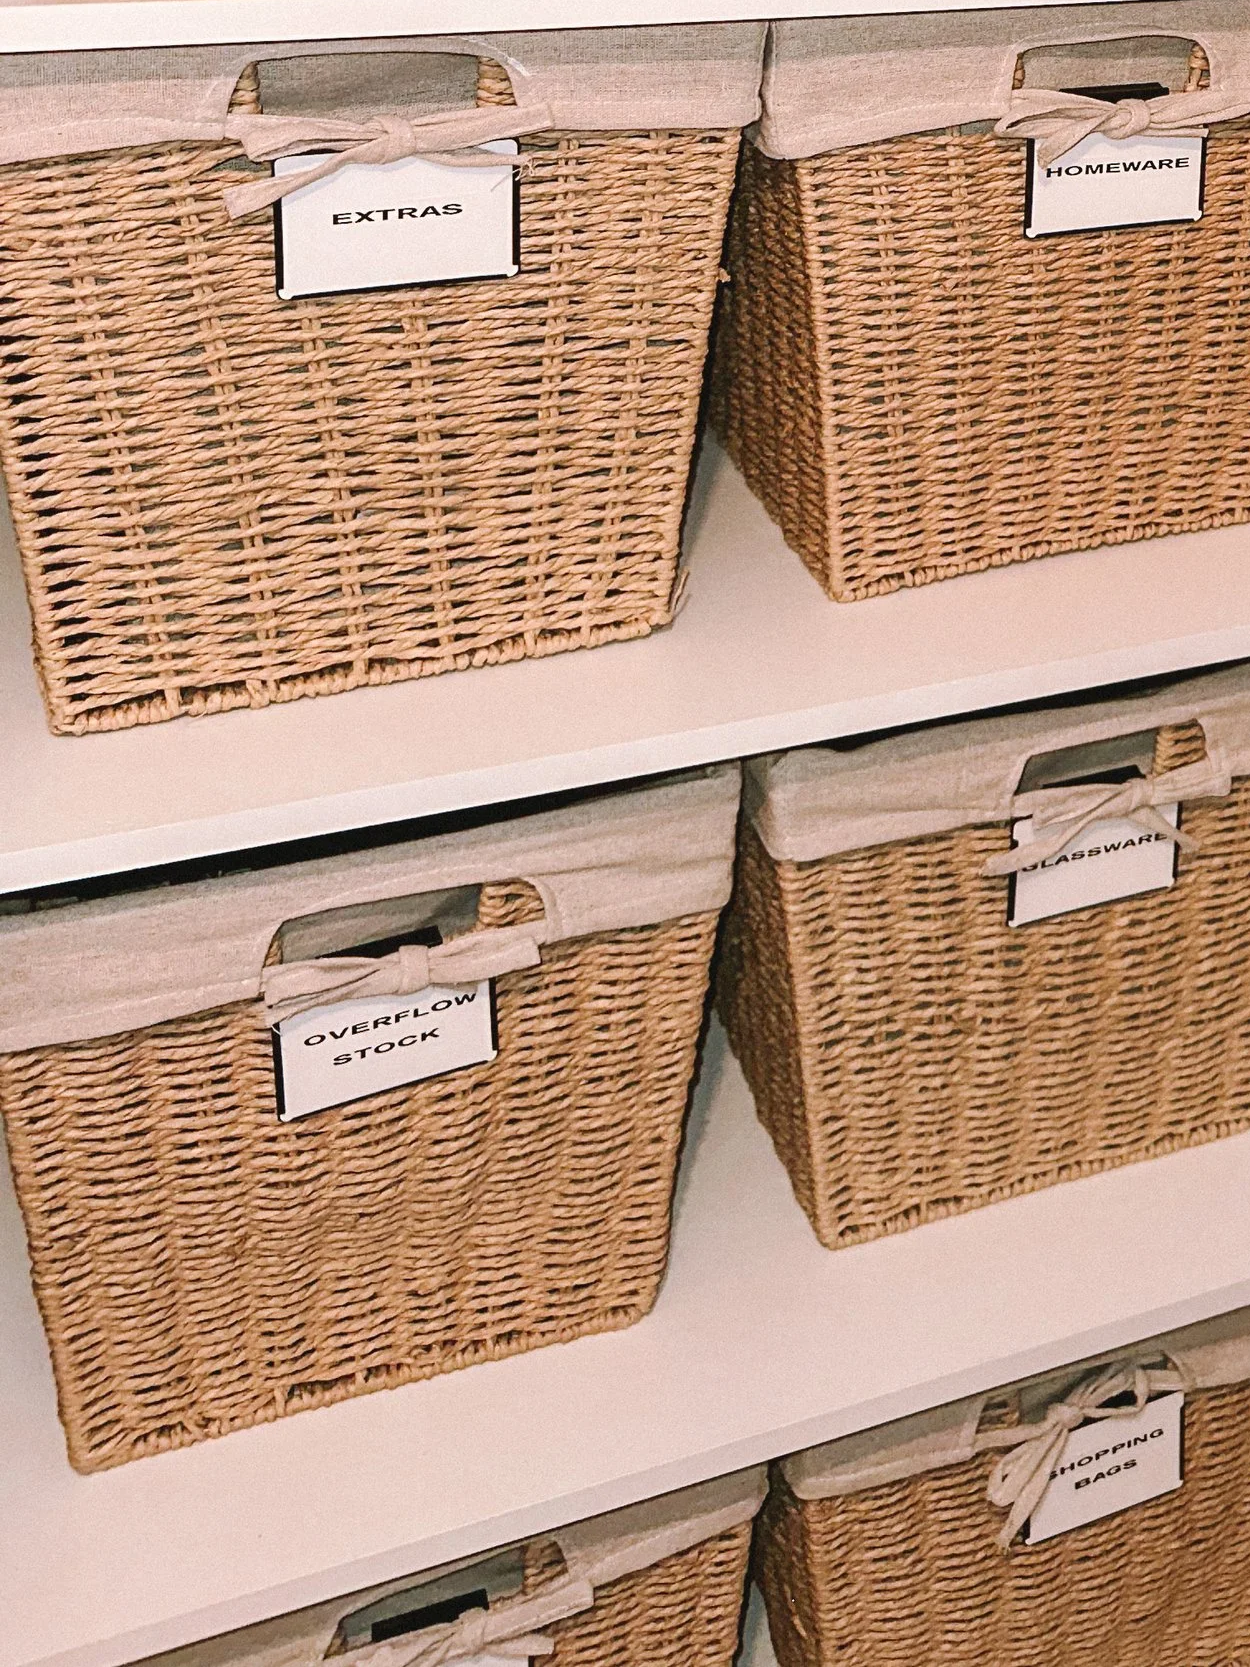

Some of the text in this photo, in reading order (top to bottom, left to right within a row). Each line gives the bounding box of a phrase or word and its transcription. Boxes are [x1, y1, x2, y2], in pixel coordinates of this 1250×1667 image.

[1045, 156, 1190, 179] HOMEWARE
[332, 202, 464, 226] EXTRAS
[303, 992, 477, 1047] OVERFLOW
[332, 1027, 441, 1066] STOCK
[1073, 1458, 1138, 1491] BAGS
